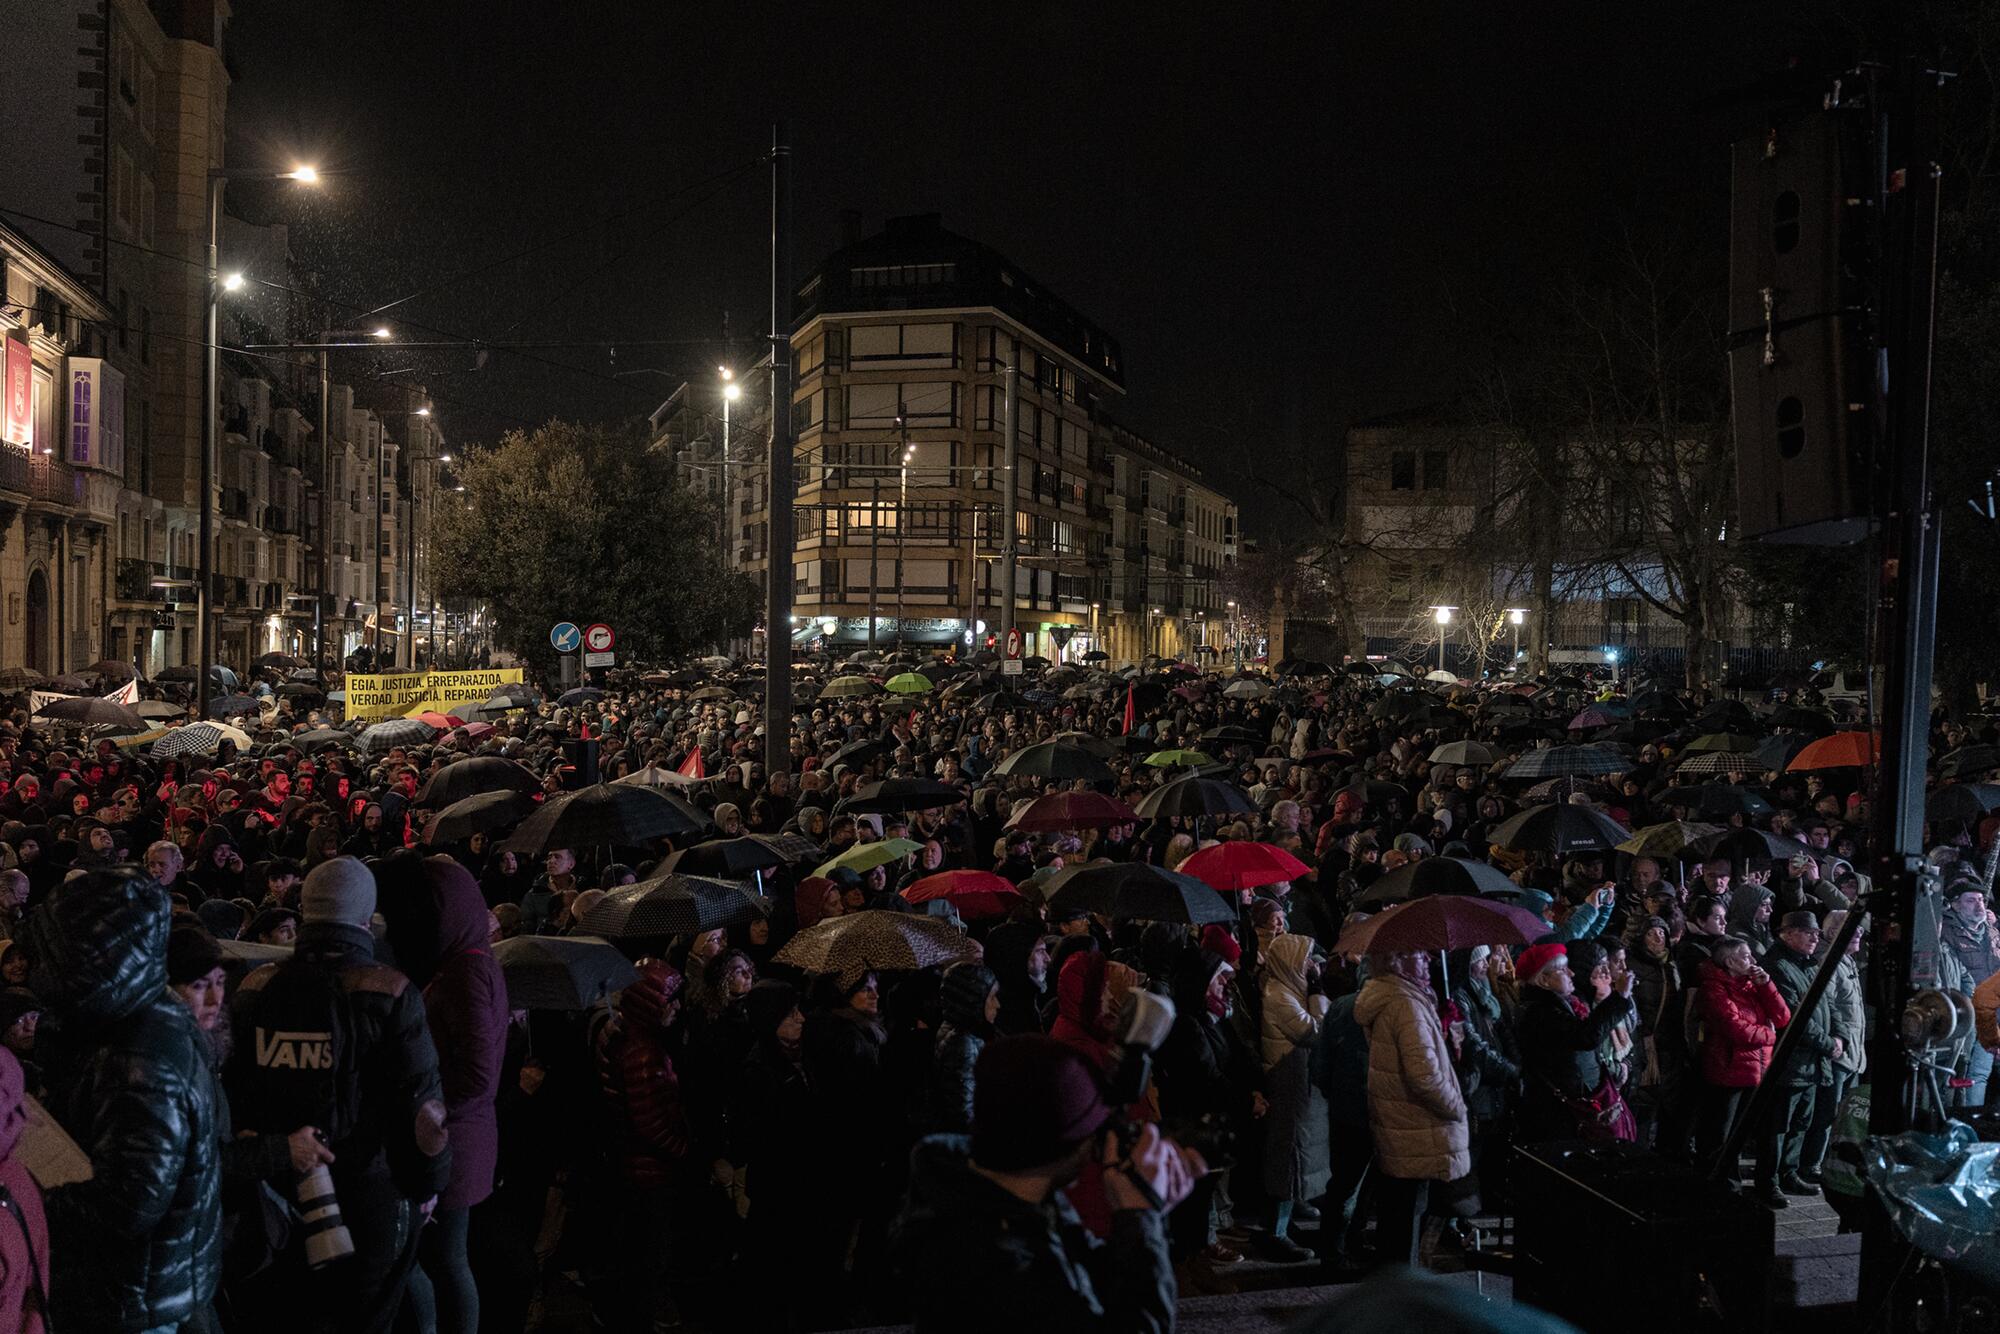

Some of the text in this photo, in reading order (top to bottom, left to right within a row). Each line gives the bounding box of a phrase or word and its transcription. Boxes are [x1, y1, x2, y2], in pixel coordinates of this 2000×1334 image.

[941, 619, 960, 627] PUB
[351, 673, 505, 691] EGIA. JUSTIZIA. ERREPARAZIOA.
[351, 688, 494, 705] VERDAD. JUSTICIA. REPARAC
[256, 1026, 333, 1069] VANS
